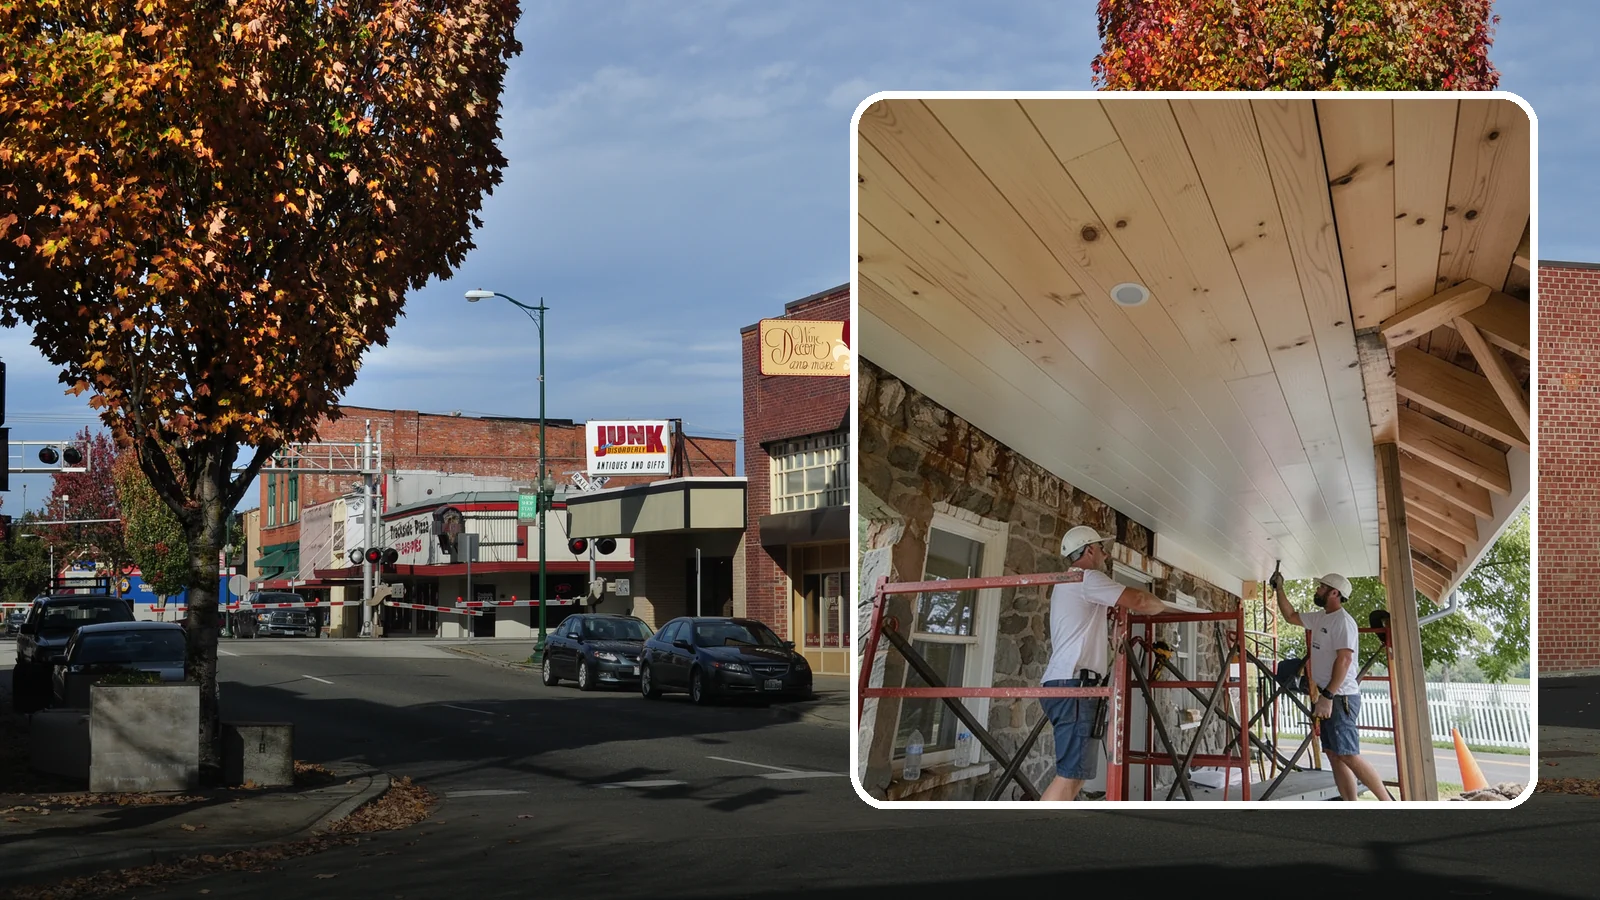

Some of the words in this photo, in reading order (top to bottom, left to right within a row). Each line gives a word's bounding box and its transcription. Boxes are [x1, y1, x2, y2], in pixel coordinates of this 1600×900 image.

[765, 327, 831, 365] Decor
[595, 425, 665, 457] JUNK
[607, 446, 645, 454] DISORDERLY
[597, 461, 628, 470] ANTIQUES
[631, 461, 644, 470] AND
[647, 460, 665, 469] GIFTS
[390, 522, 413, 540] Trackside
[414, 520, 429, 534] Pizza
